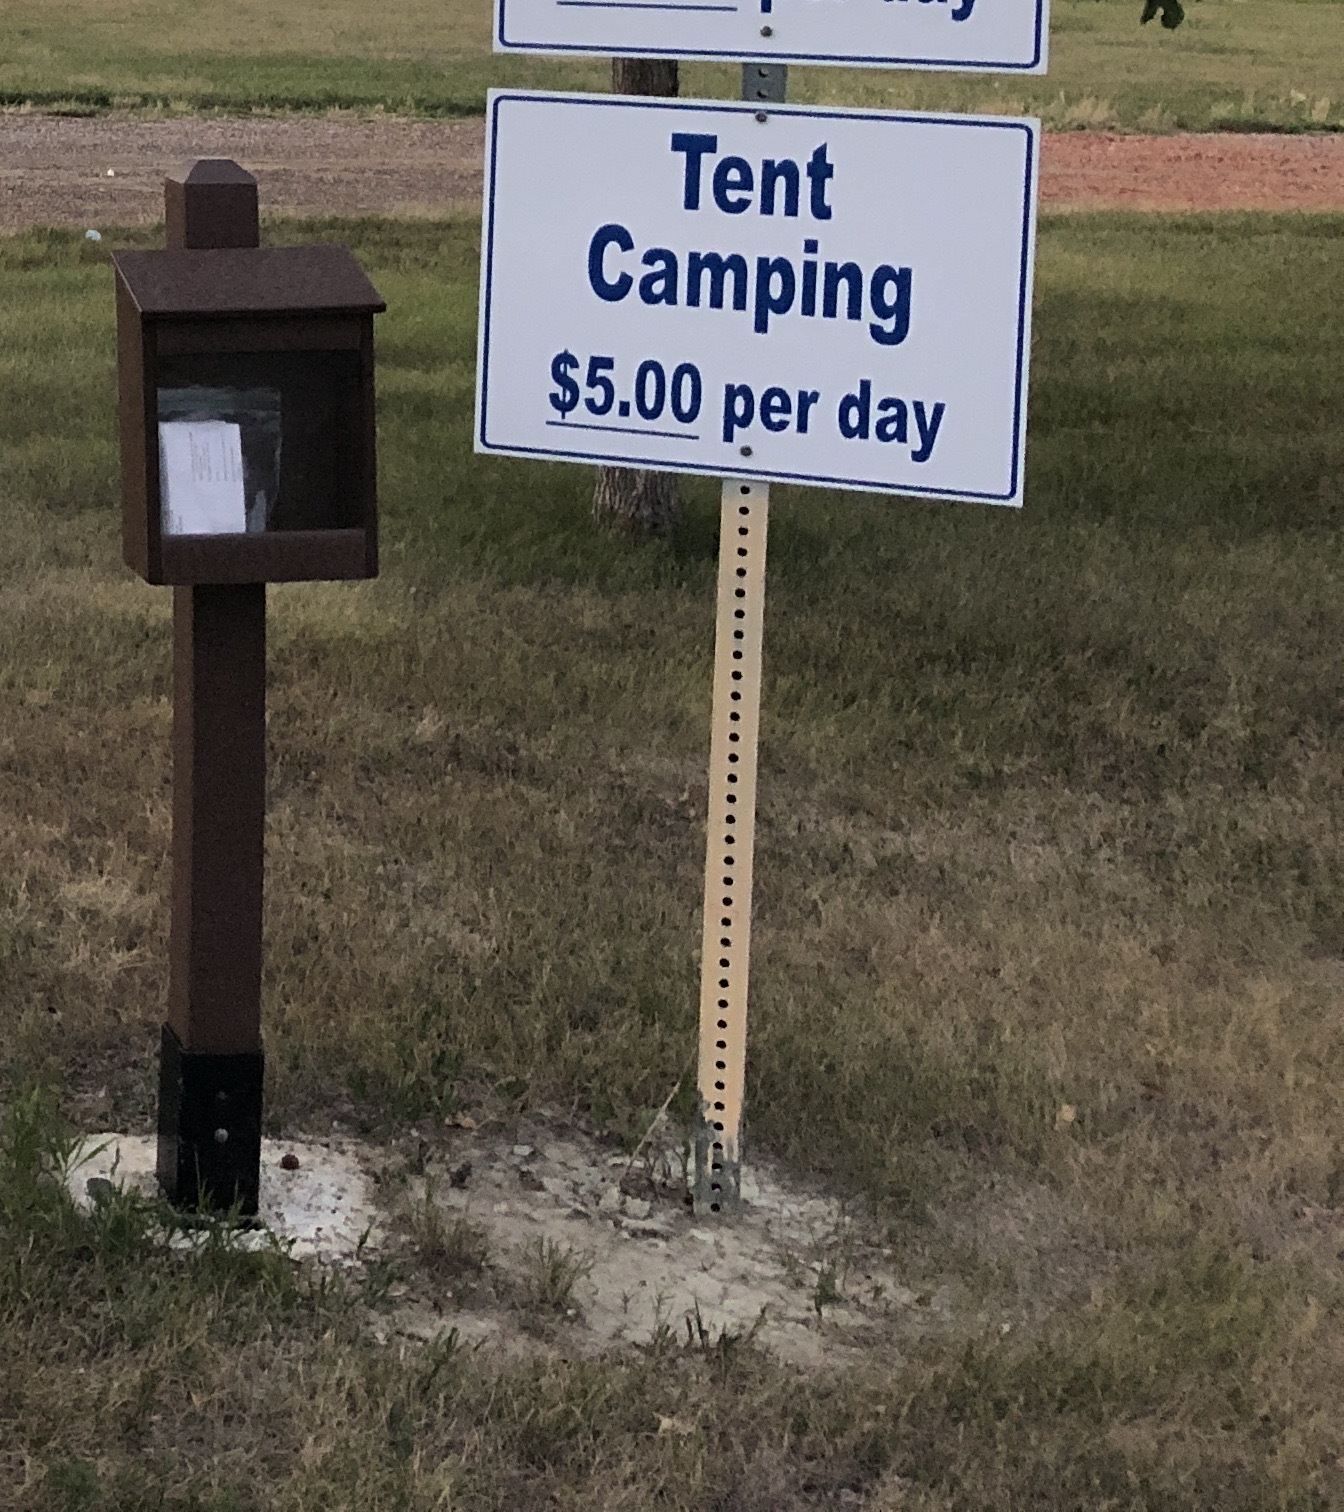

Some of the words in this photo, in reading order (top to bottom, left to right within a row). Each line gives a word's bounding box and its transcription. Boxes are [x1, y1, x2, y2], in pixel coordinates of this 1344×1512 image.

[670, 132, 835, 221] Tent
[588, 224, 913, 347] Camping
[548, 349, 703, 425] $5.00
[722, 383, 820, 443] per
[838, 379, 946, 463] day
